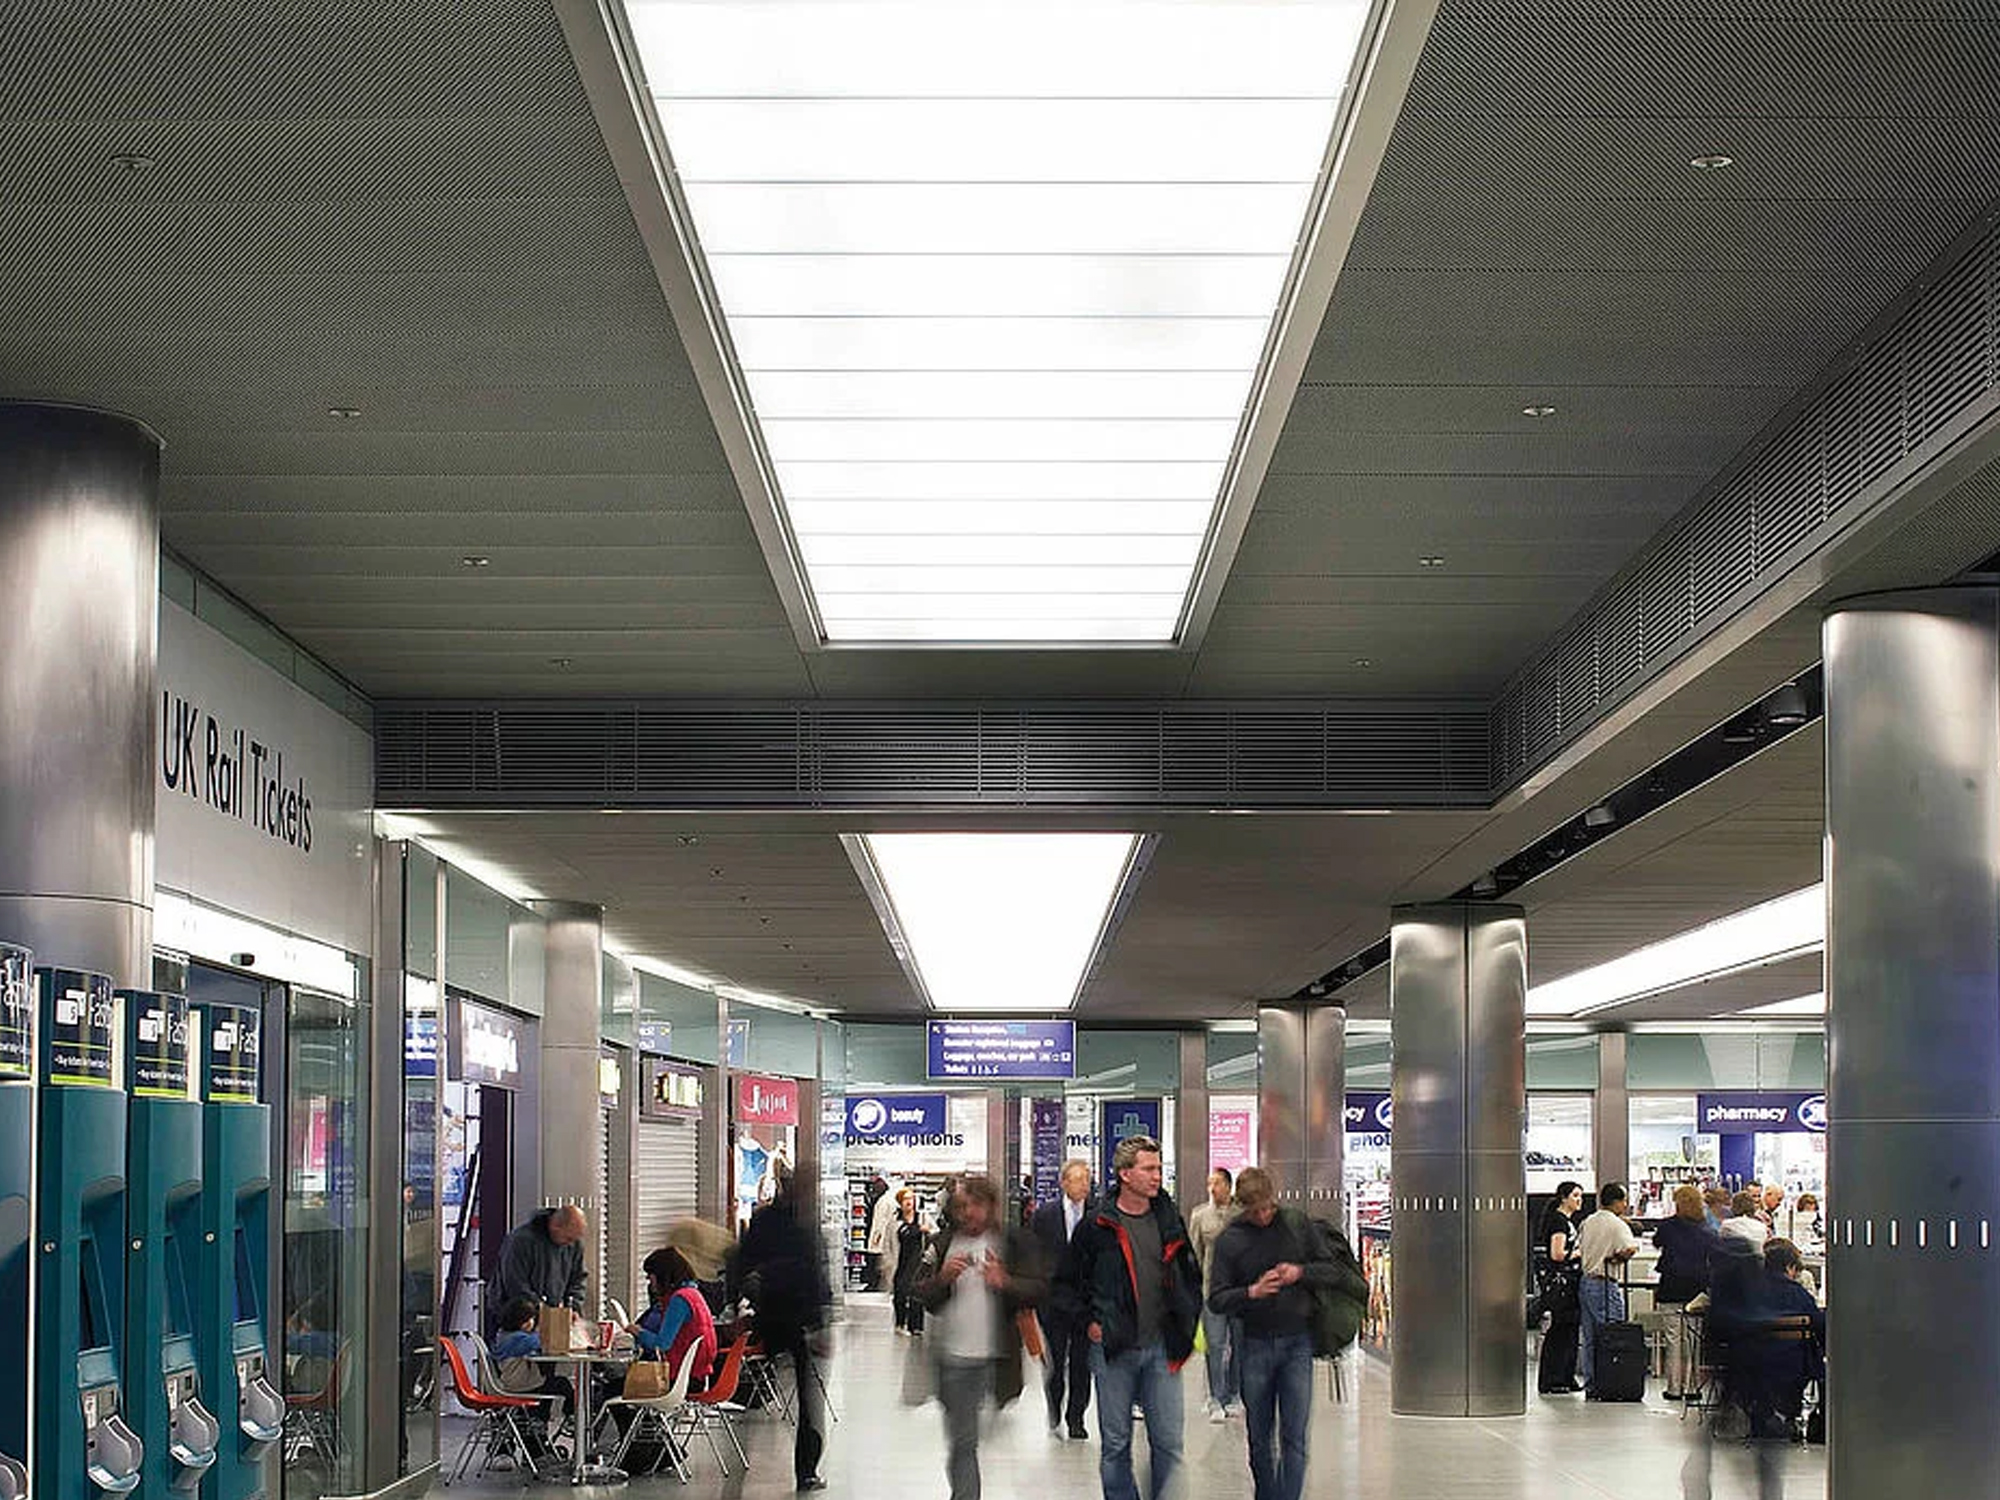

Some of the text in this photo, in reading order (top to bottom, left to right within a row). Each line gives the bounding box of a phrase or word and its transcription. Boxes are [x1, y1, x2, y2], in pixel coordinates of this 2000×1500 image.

[163, 690, 312, 853] UK Rail Tickets
[890, 1107, 925, 1124] beauty
[1706, 1104, 1788, 1122] pharmacy
